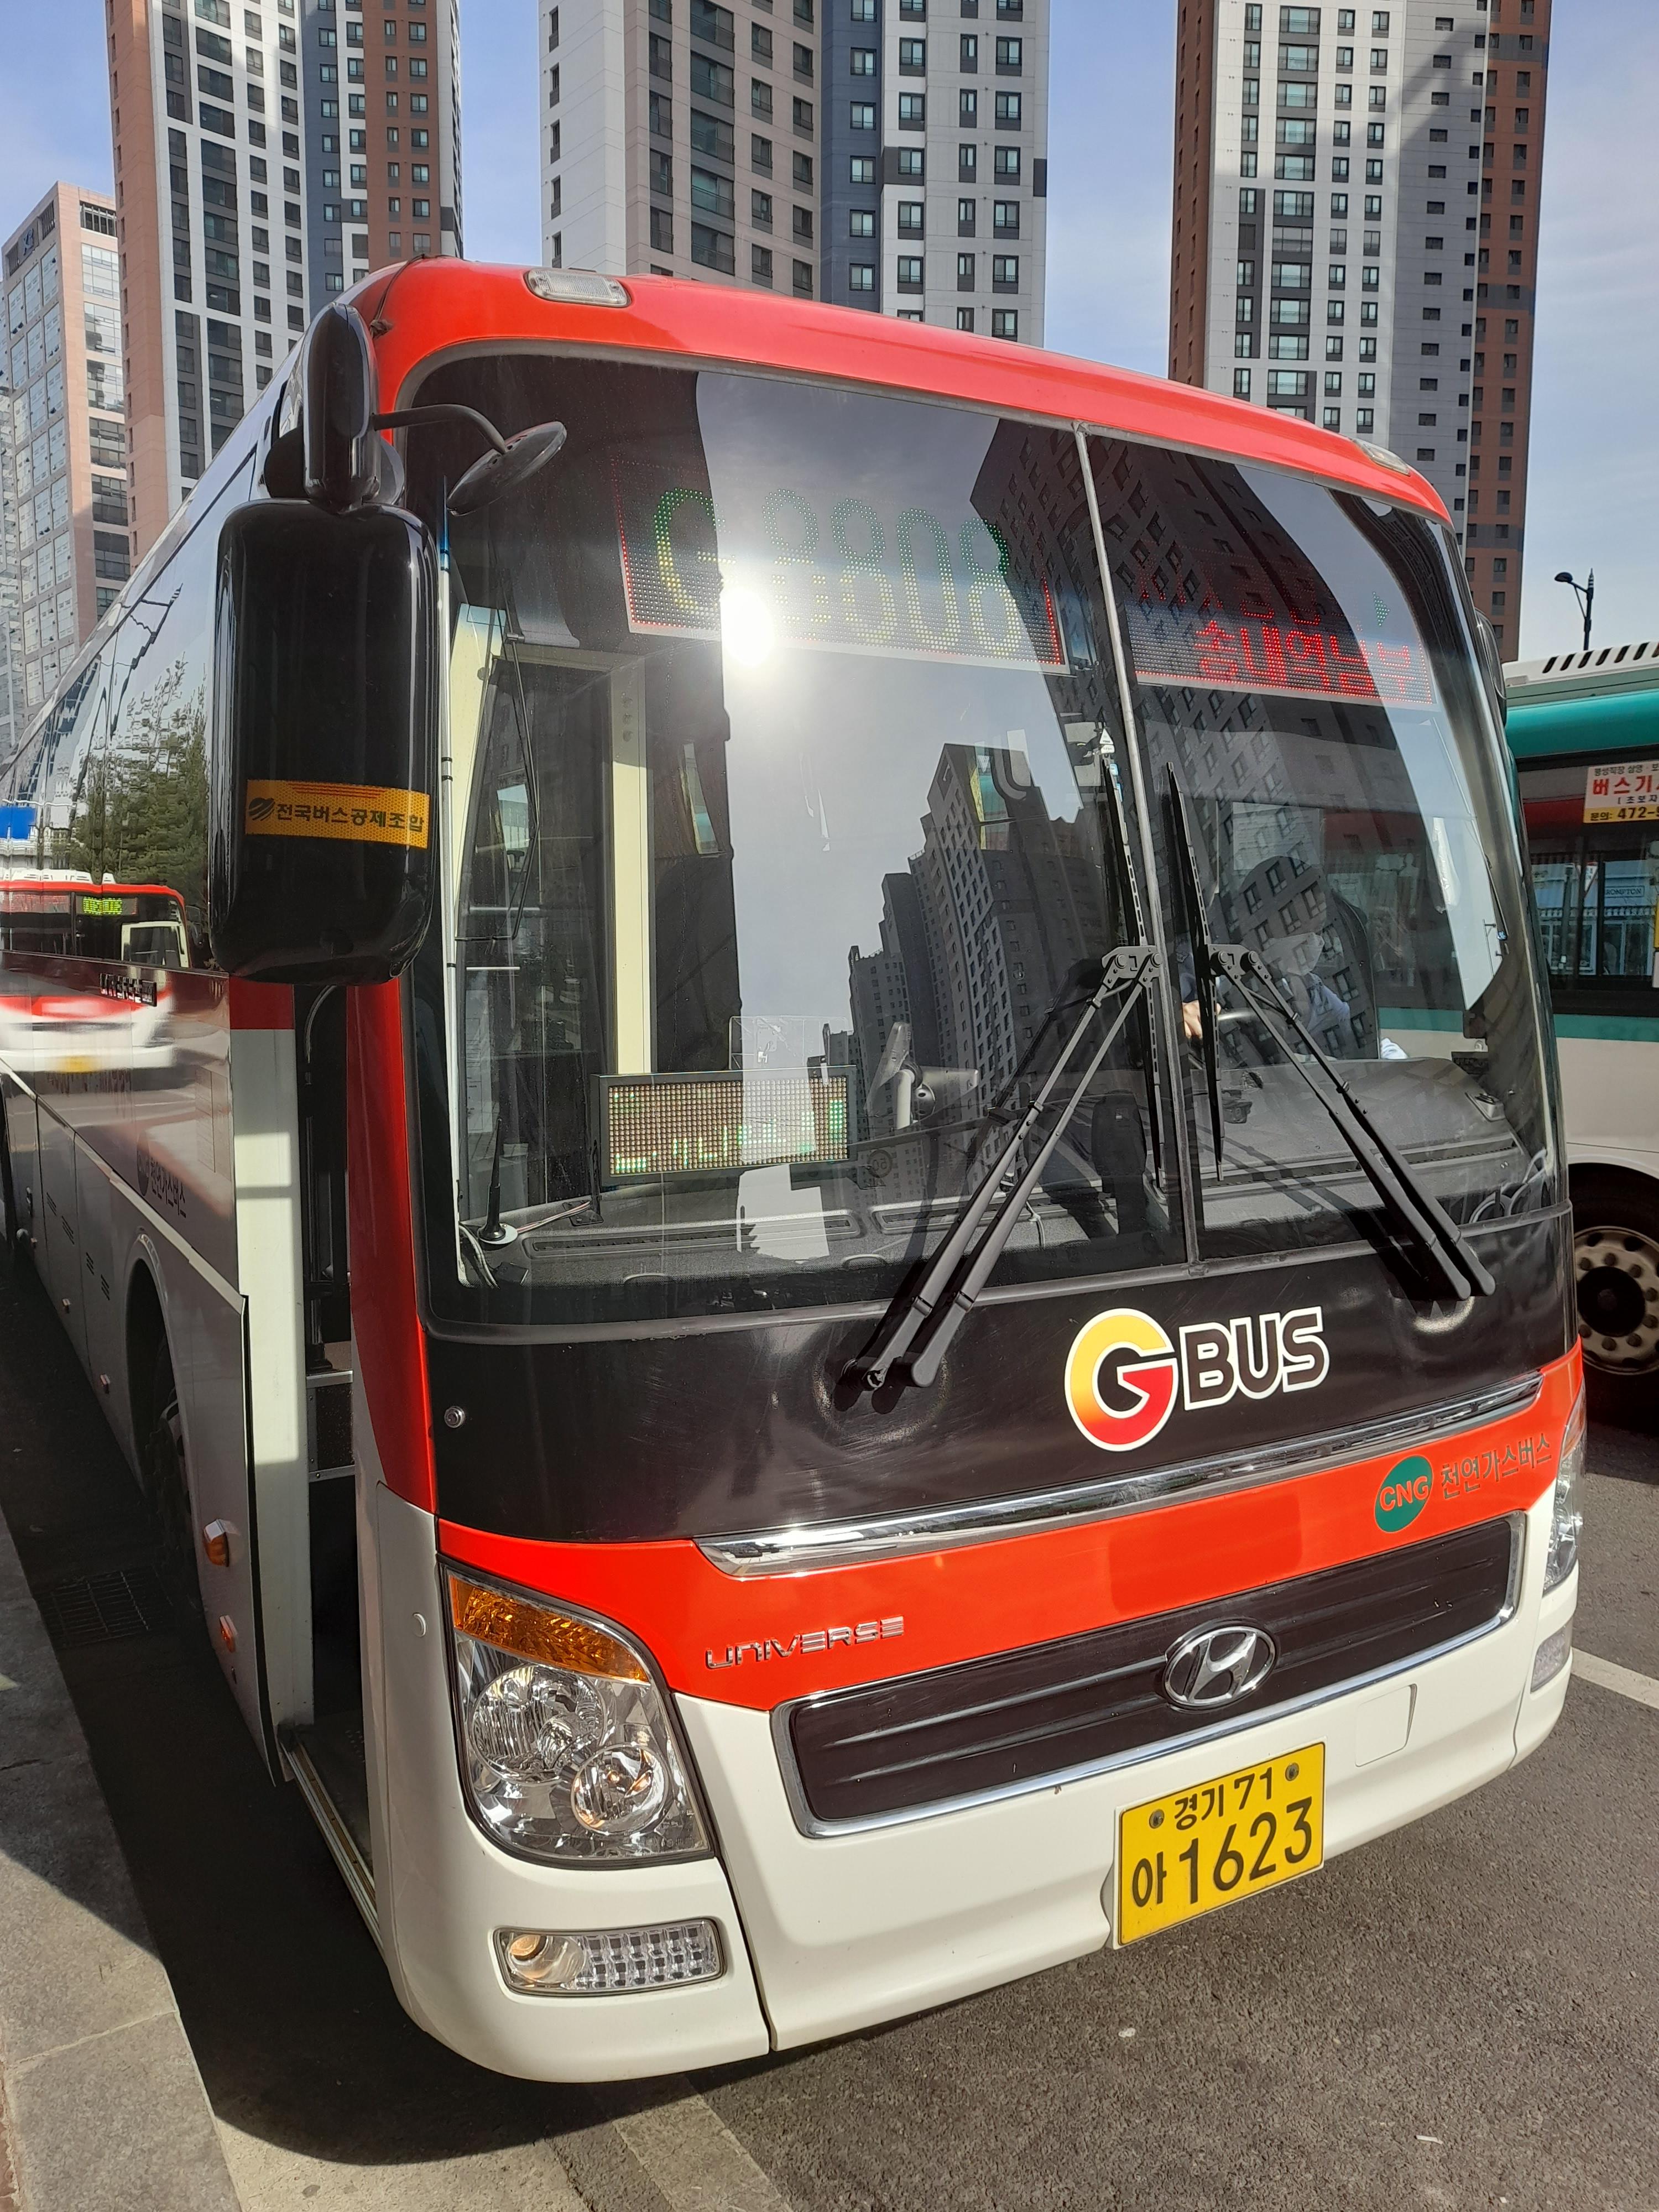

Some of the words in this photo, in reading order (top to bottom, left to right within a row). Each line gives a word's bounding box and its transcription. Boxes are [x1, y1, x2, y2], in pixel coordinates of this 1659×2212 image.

[1193, 620, 1416, 694] 송내역남부
[277, 803, 424, 832] 전국버스공제조합
[1593, 775, 1659, 796] 버스기
[1179, 1306, 1329, 1411] BUS
[1380, 1476, 1430, 1511] CNG
[1441, 1433, 1552, 1500] 천연가스버스
[705, 1616, 904, 1669] UNIVERSE
[1174, 1793, 1224, 1831] 경기
[1234, 1766, 1272, 1811] 71
[1131, 1851, 1167, 1908] 아
[1178, 1796, 1313, 1905] 1623
